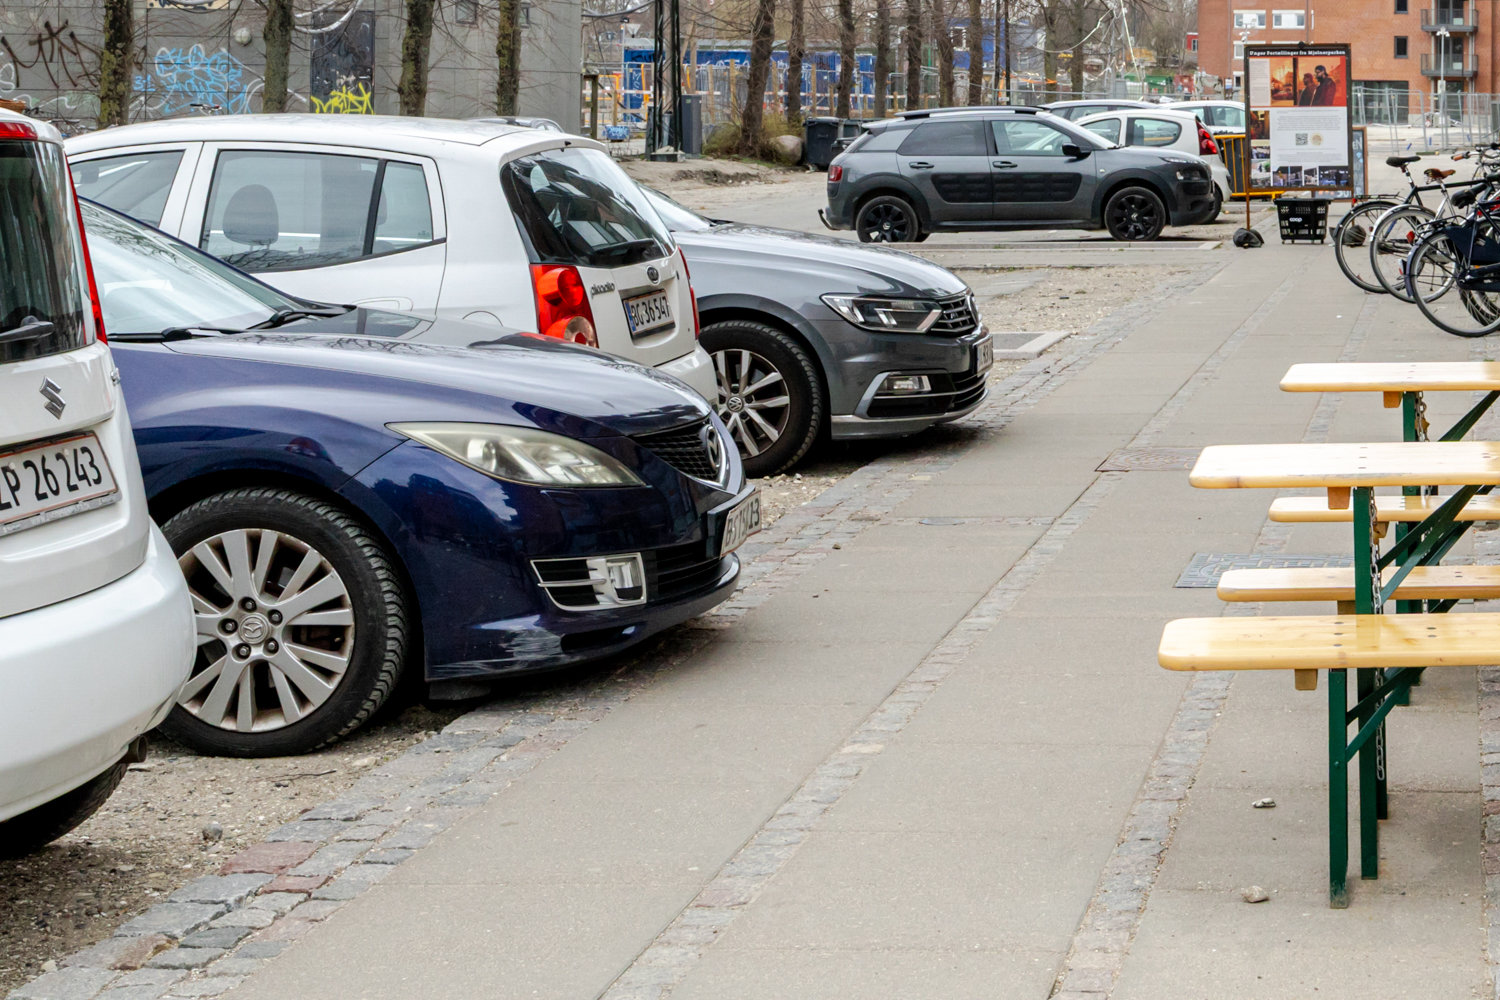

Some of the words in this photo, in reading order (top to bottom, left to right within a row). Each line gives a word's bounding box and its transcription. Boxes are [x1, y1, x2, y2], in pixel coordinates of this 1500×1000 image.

[641, 299, 656, 323] 36
[653, 295, 670, 320] 547
[22, 454, 60, 502] 26
[54, 445, 102, 493] 243
